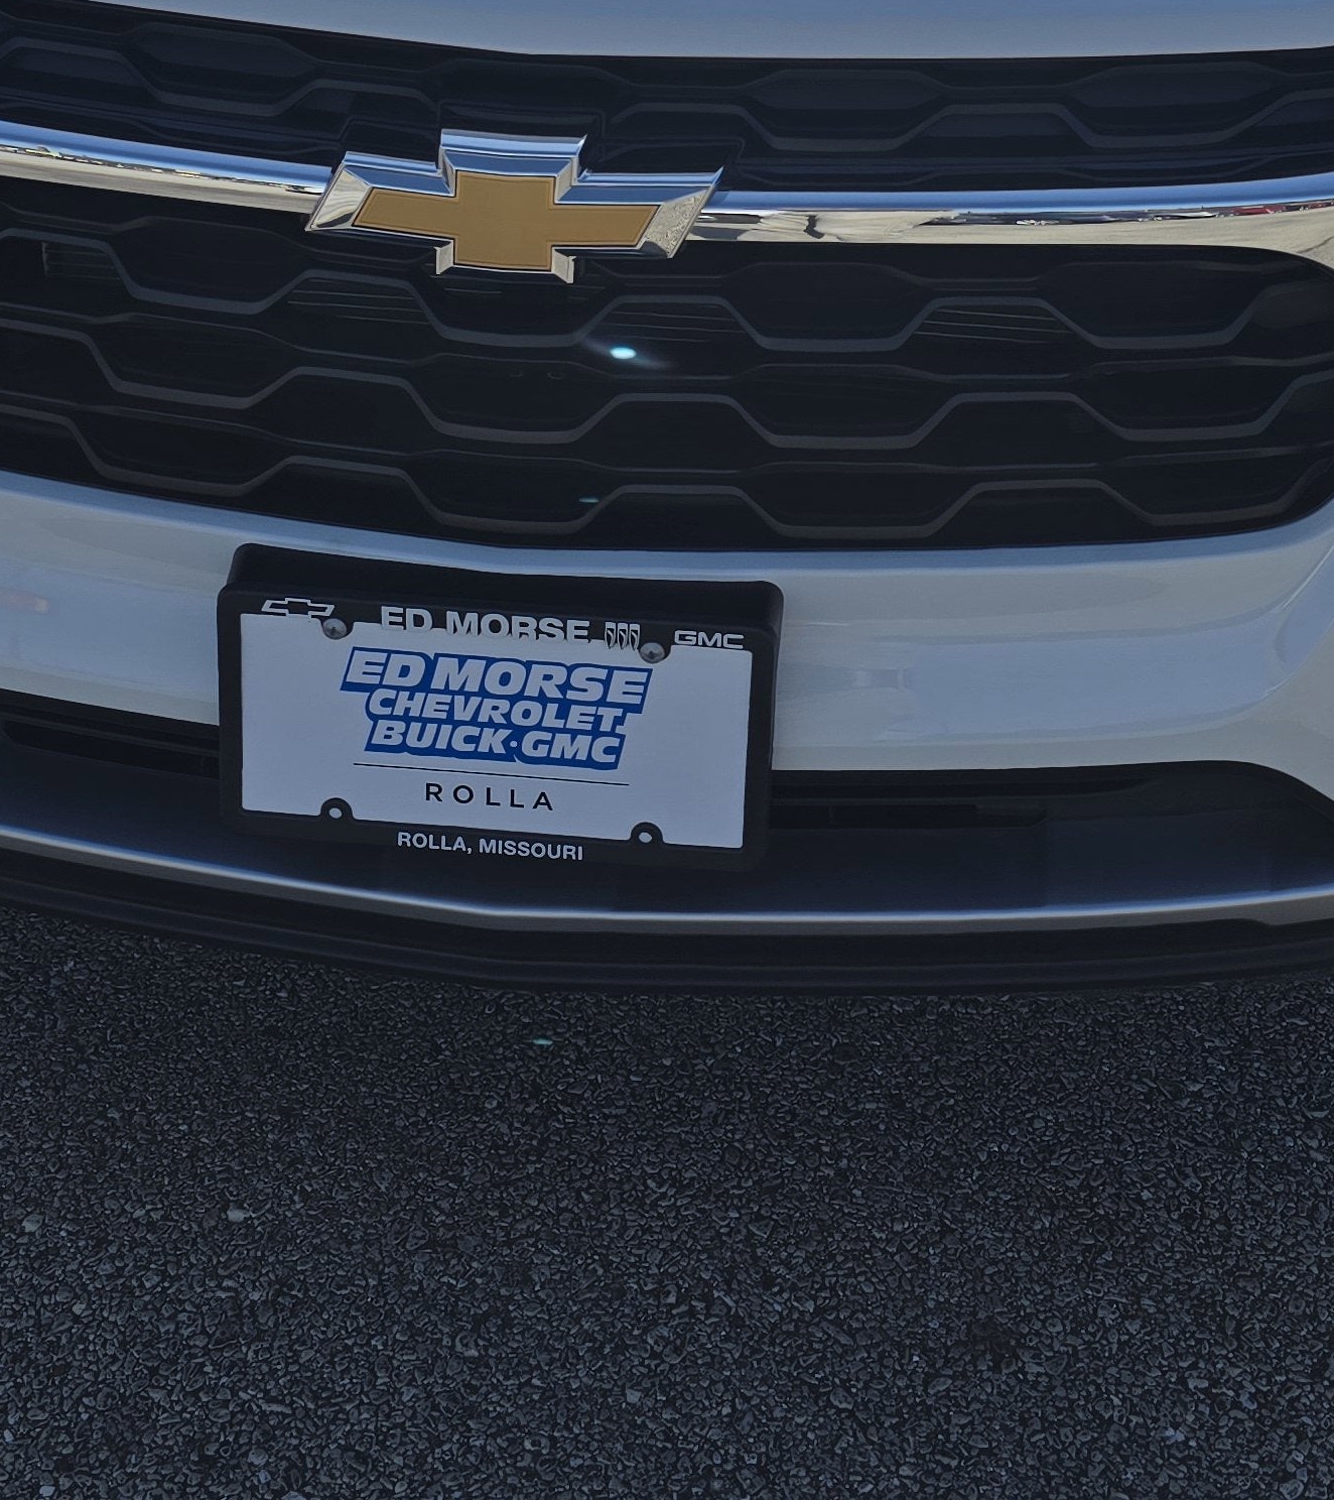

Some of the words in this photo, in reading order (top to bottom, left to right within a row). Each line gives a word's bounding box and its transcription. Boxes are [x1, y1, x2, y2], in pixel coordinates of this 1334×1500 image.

[380, 605, 433, 632] ED
[445, 610, 591, 644] MORSE
[674, 629, 745, 650] GMC
[345, 649, 426, 688] ED
[430, 656, 649, 705] MORSE
[368, 687, 624, 732] CHEVROLET
[425, 782, 554, 811] ROLLA
[397, 831, 473, 855] ROLLA,
[478, 838, 584, 861] MISSOURI
